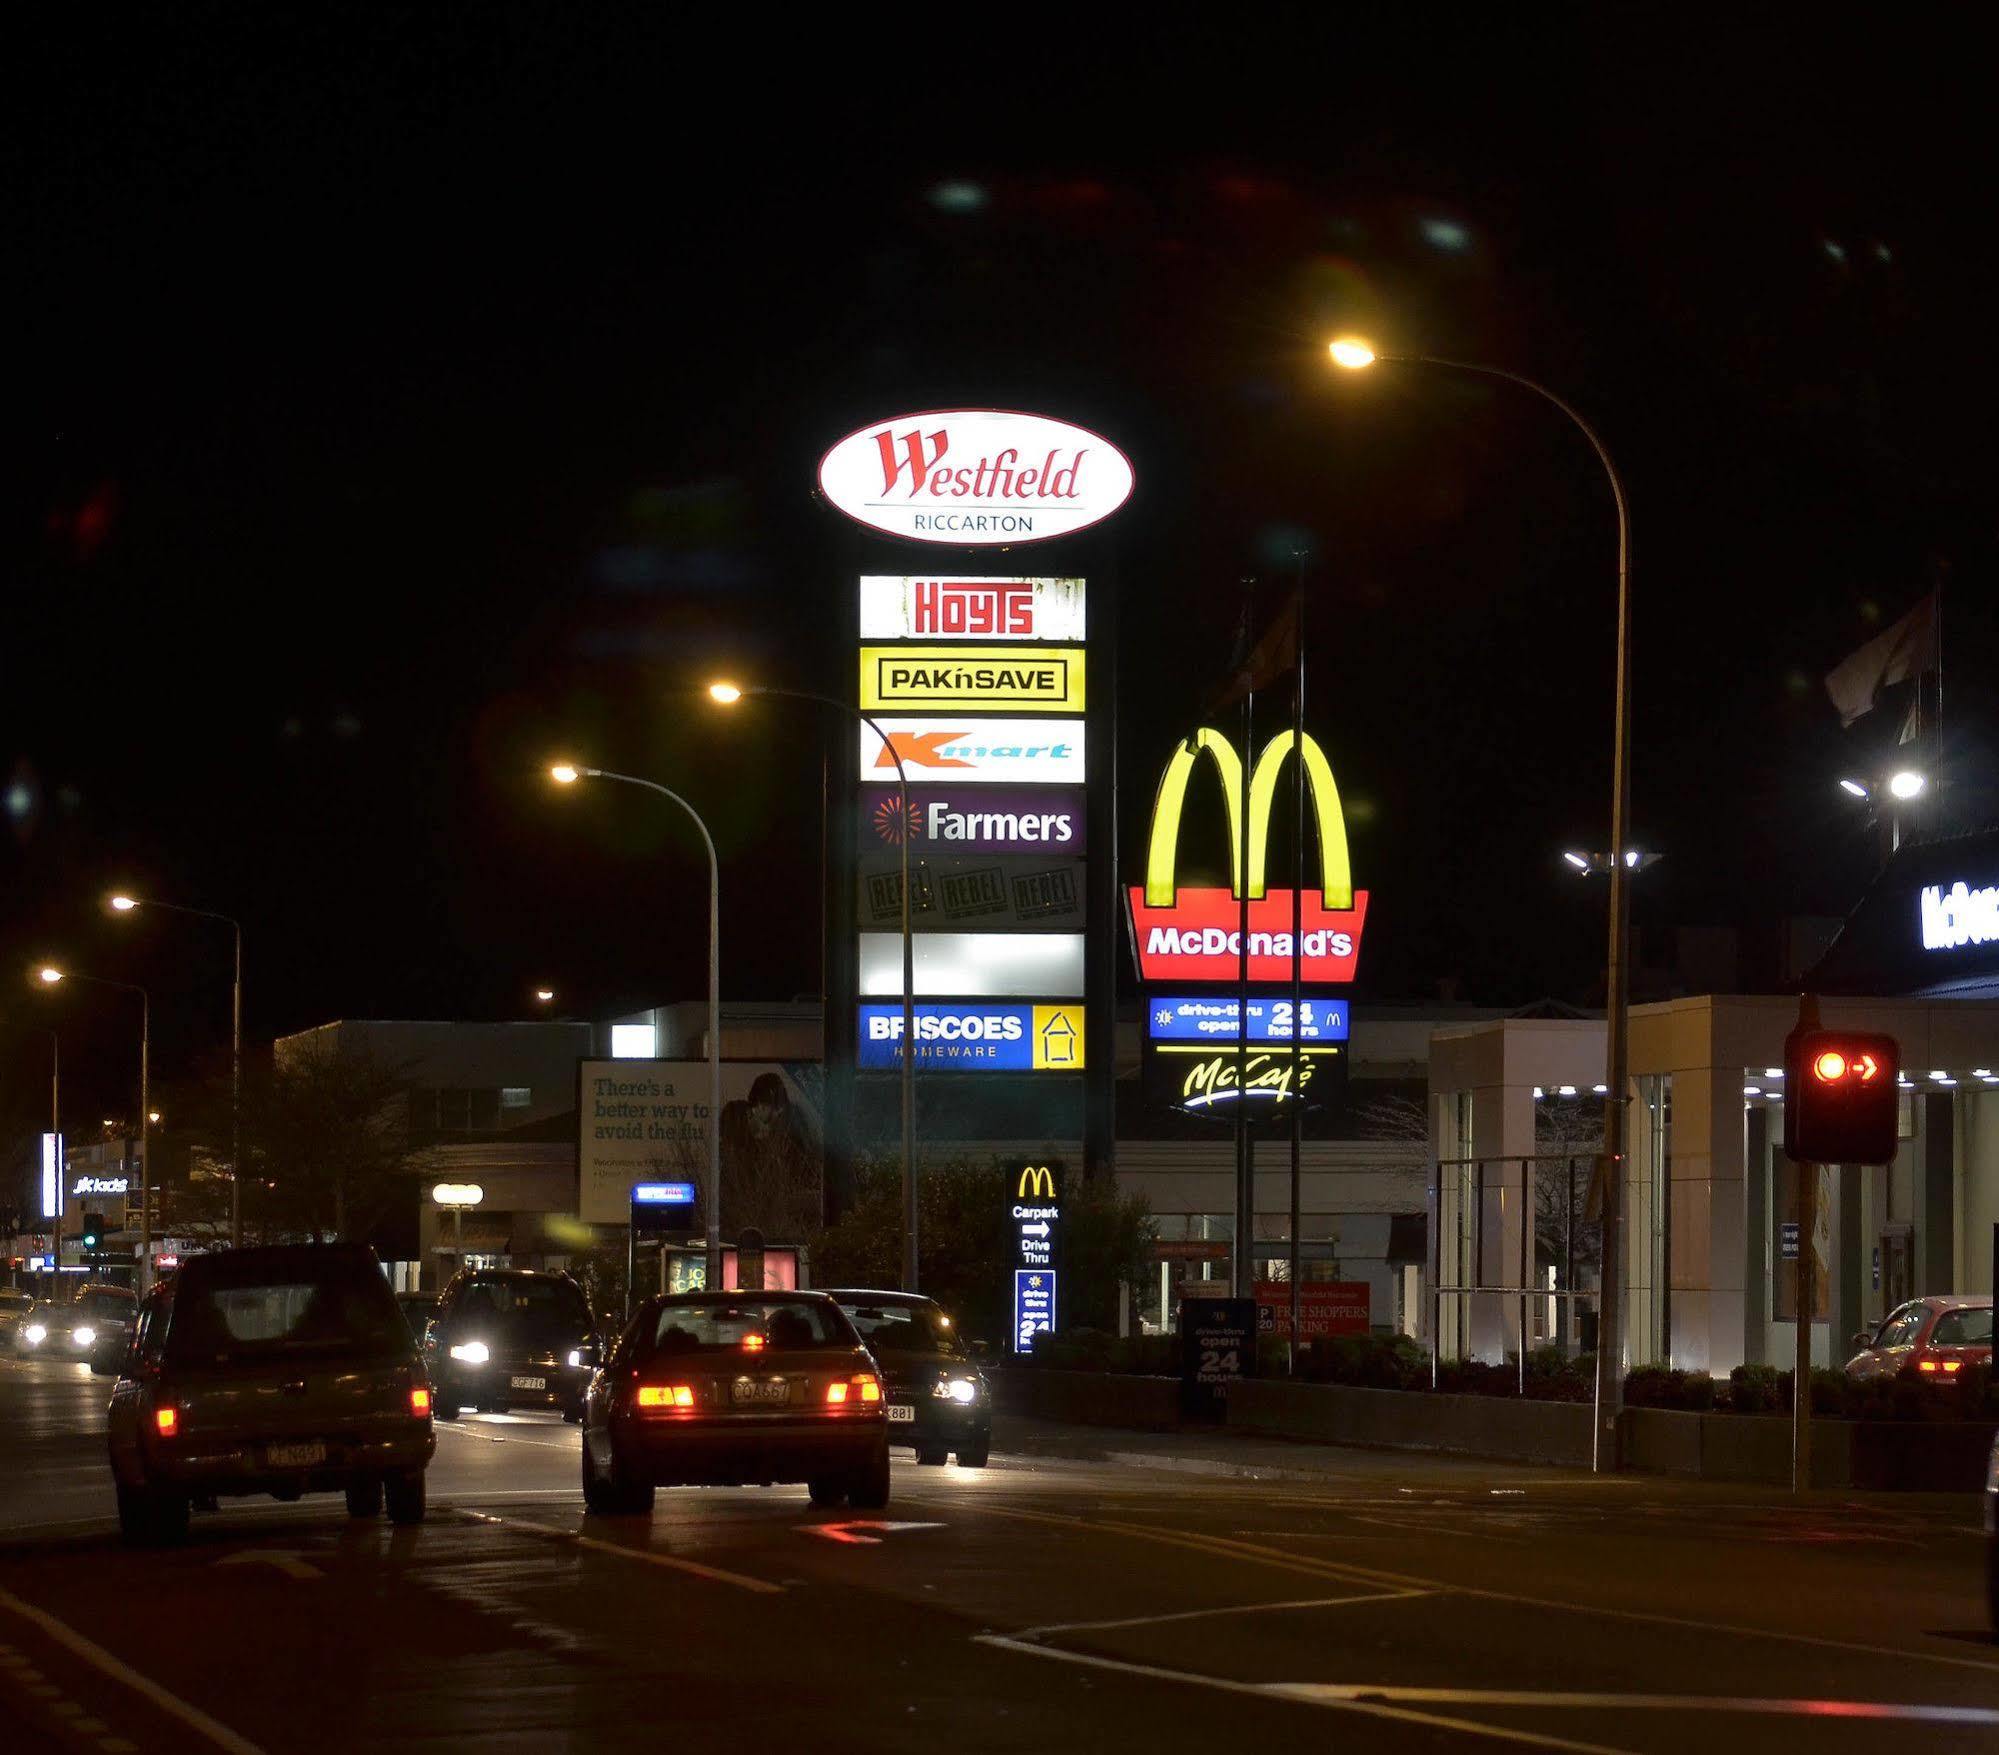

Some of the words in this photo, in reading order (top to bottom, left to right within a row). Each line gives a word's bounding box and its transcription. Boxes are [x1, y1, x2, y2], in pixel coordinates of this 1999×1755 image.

[869, 428, 1090, 498] Westfield
[915, 514, 1033, 532] RICCARTON
[915, 582, 1033, 634] HOYTS
[928, 802, 1073, 841] Farmers
[1271, 1003, 1315, 1025] 24
[894, 1046, 997, 1057] HMEWARE
[593, 1078, 661, 1097] There's
[664, 1083, 676, 1097] a
[594, 1100, 648, 1118] better
[652, 1104, 689, 1121] way
[693, 1102, 710, 1119] to
[594, 1121, 644, 1140] avoid
[648, 1121, 676, 1140] the
[1012, 1206, 1059, 1220] Carpark
[1021, 1239, 1050, 1251] Drive
[1023, 1252, 1049, 1264] Thru
[1022, 1290, 1049, 1299] drive
[1309, 1305, 1368, 1319] SHOPPERS
[1260, 1319, 1273, 1330] 20
[1200, 1337, 1241, 1348] open
[1200, 1350, 1241, 1372] 24
